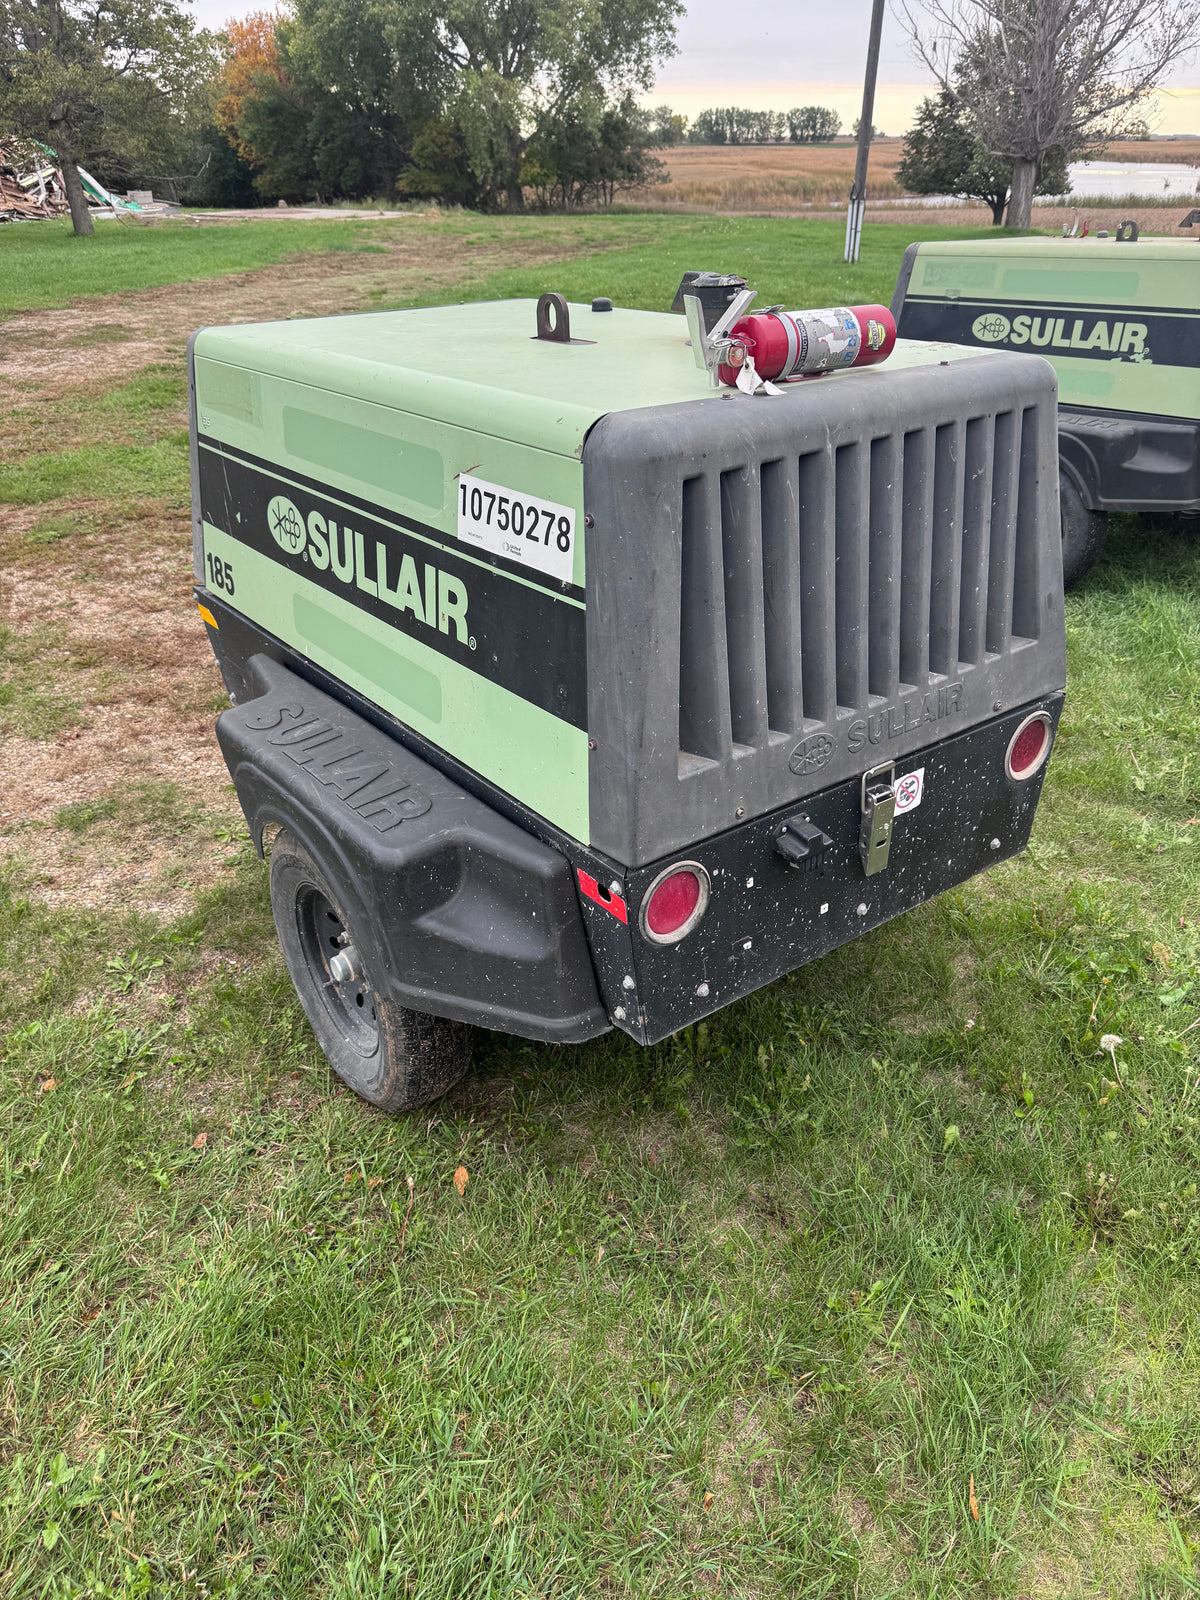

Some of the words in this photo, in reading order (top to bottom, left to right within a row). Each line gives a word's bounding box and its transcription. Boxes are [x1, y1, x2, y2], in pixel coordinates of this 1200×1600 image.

[1010, 315, 1148, 353] SULLAIR
[460, 484, 571, 553] 10750278
[207, 551, 235, 596] 185
[307, 510, 469, 646] SULLAIR
[847, 682, 964, 753] SULLAIR
[244, 703, 433, 833] SULLAIR
